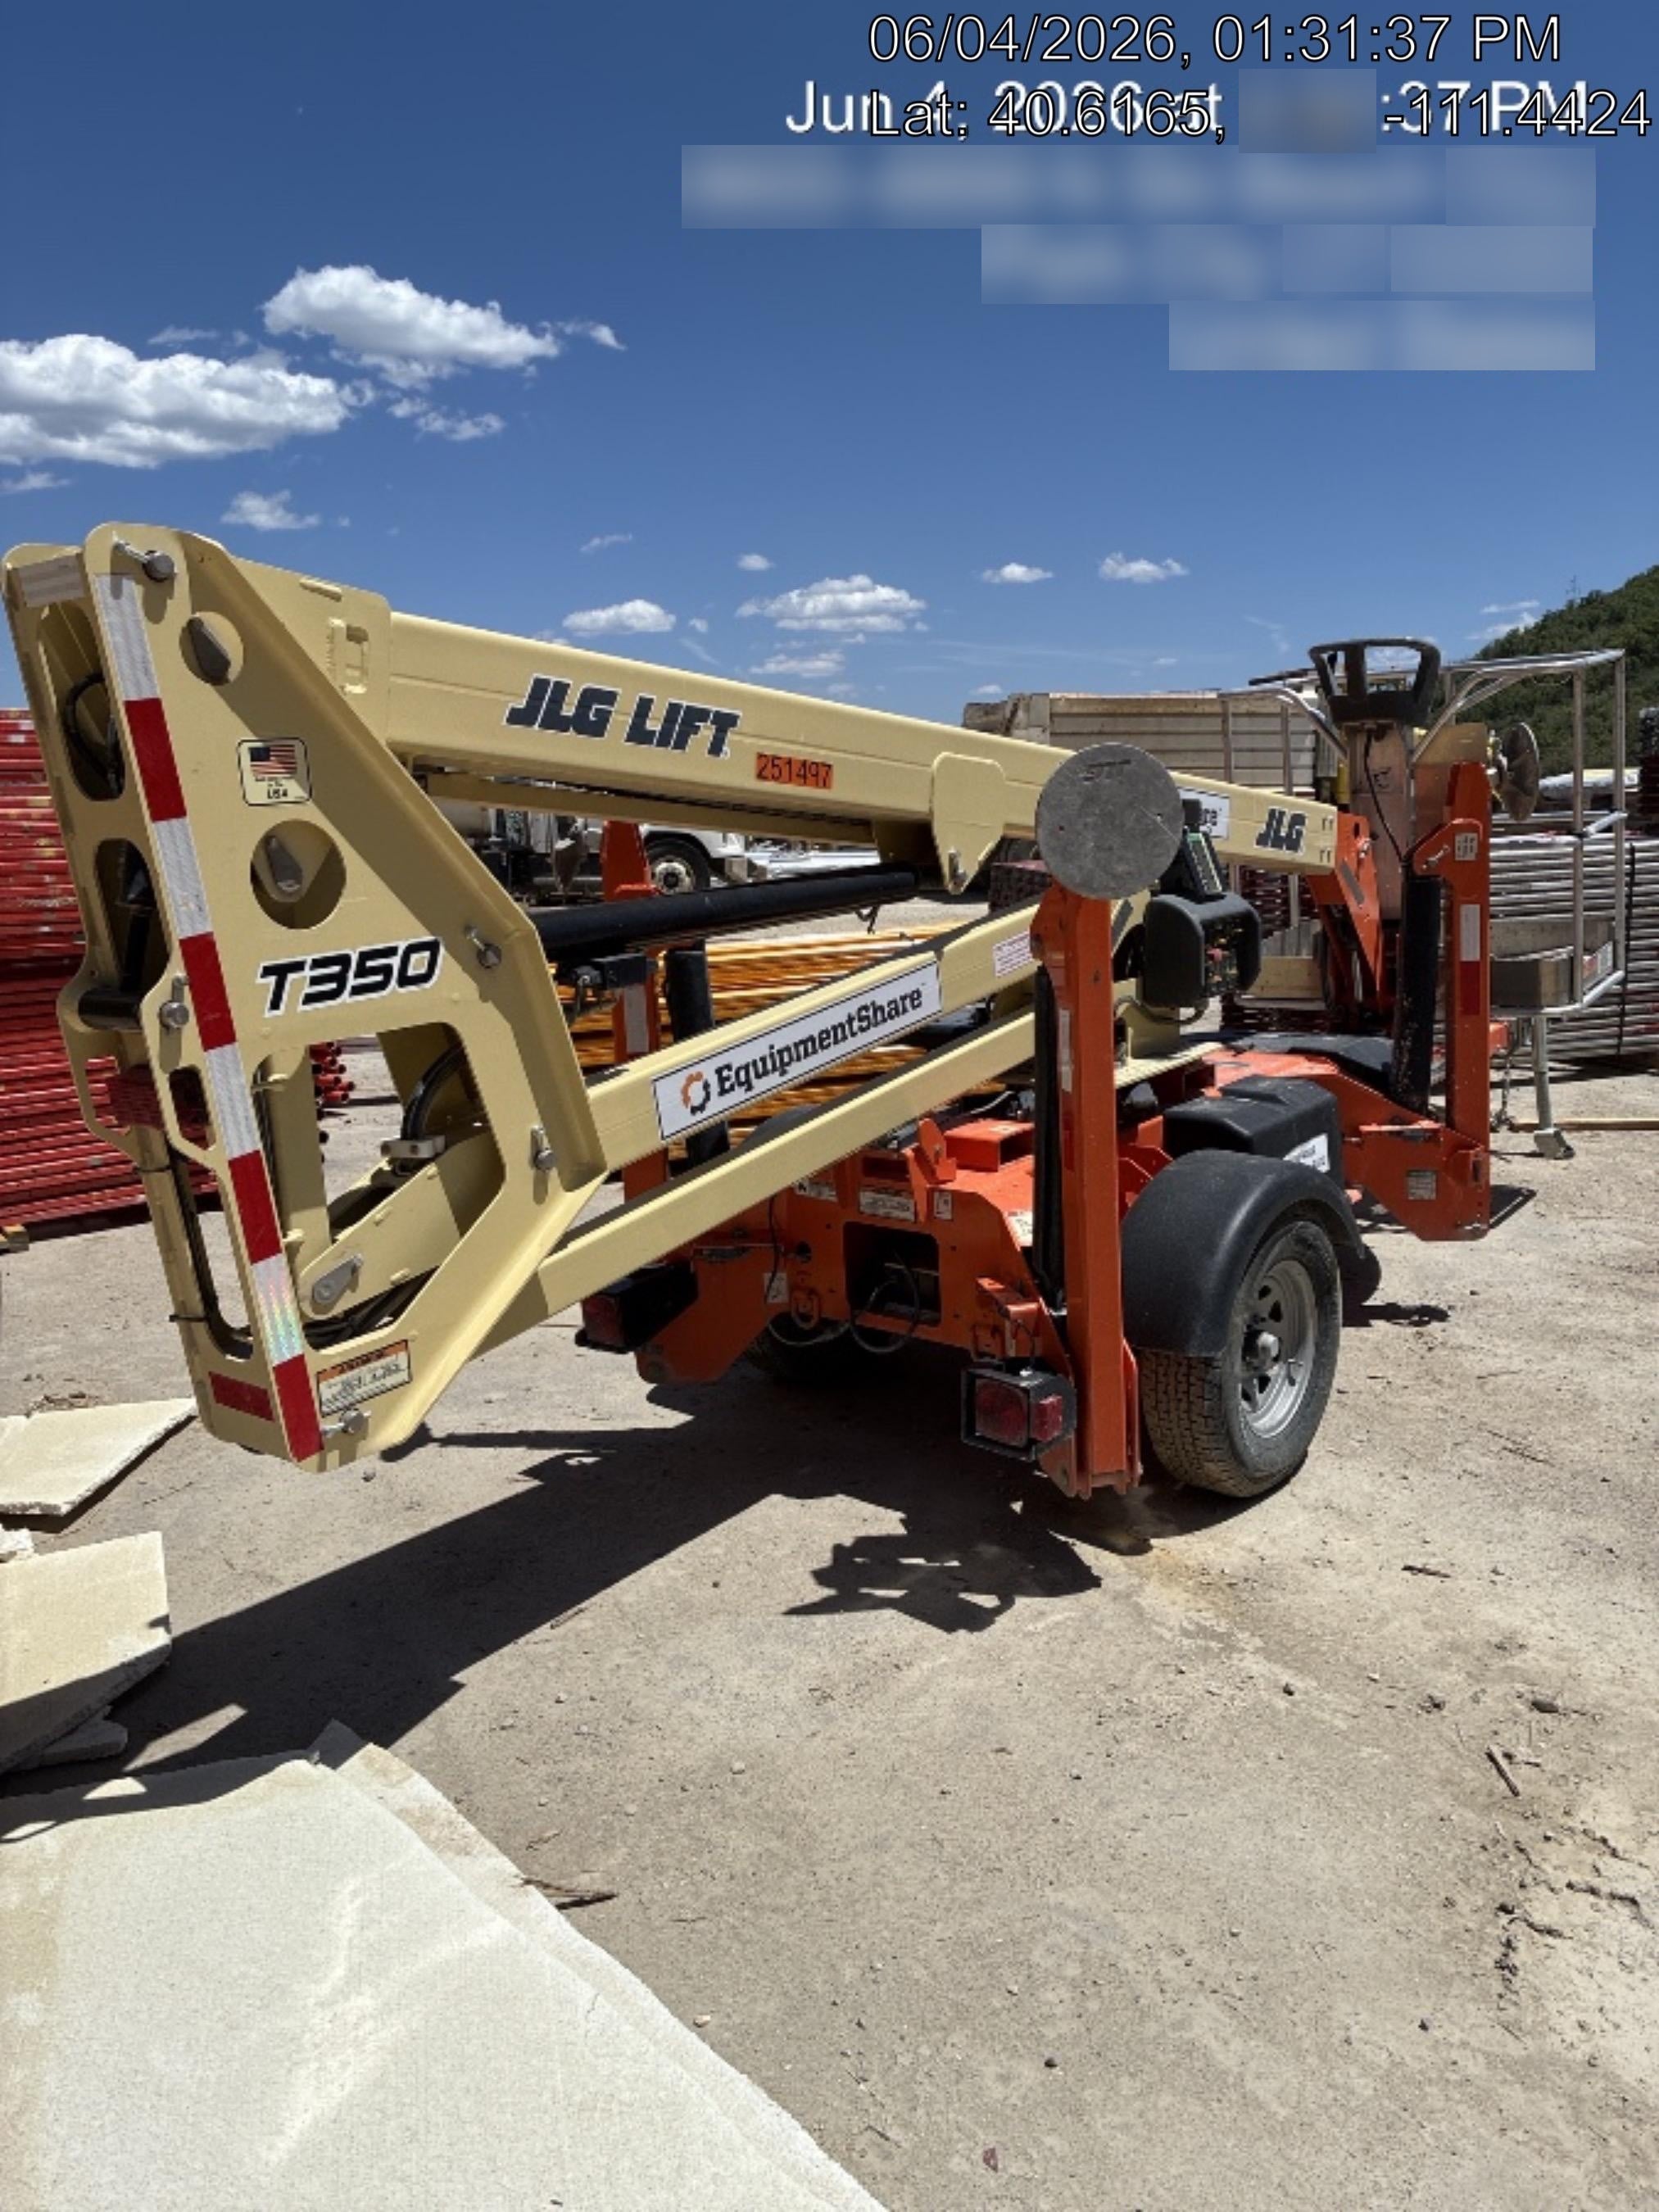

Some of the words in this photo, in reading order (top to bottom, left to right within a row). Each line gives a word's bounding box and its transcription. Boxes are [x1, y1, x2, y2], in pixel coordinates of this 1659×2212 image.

[503, 673, 622, 740] JLG
[623, 692, 742, 760] LIFT
[755, 752, 833, 790] 251497
[1253, 806, 1309, 855] JLG
[257, 936, 442, 1017] T350
[714, 986, 924, 1098] EquipmentShare
